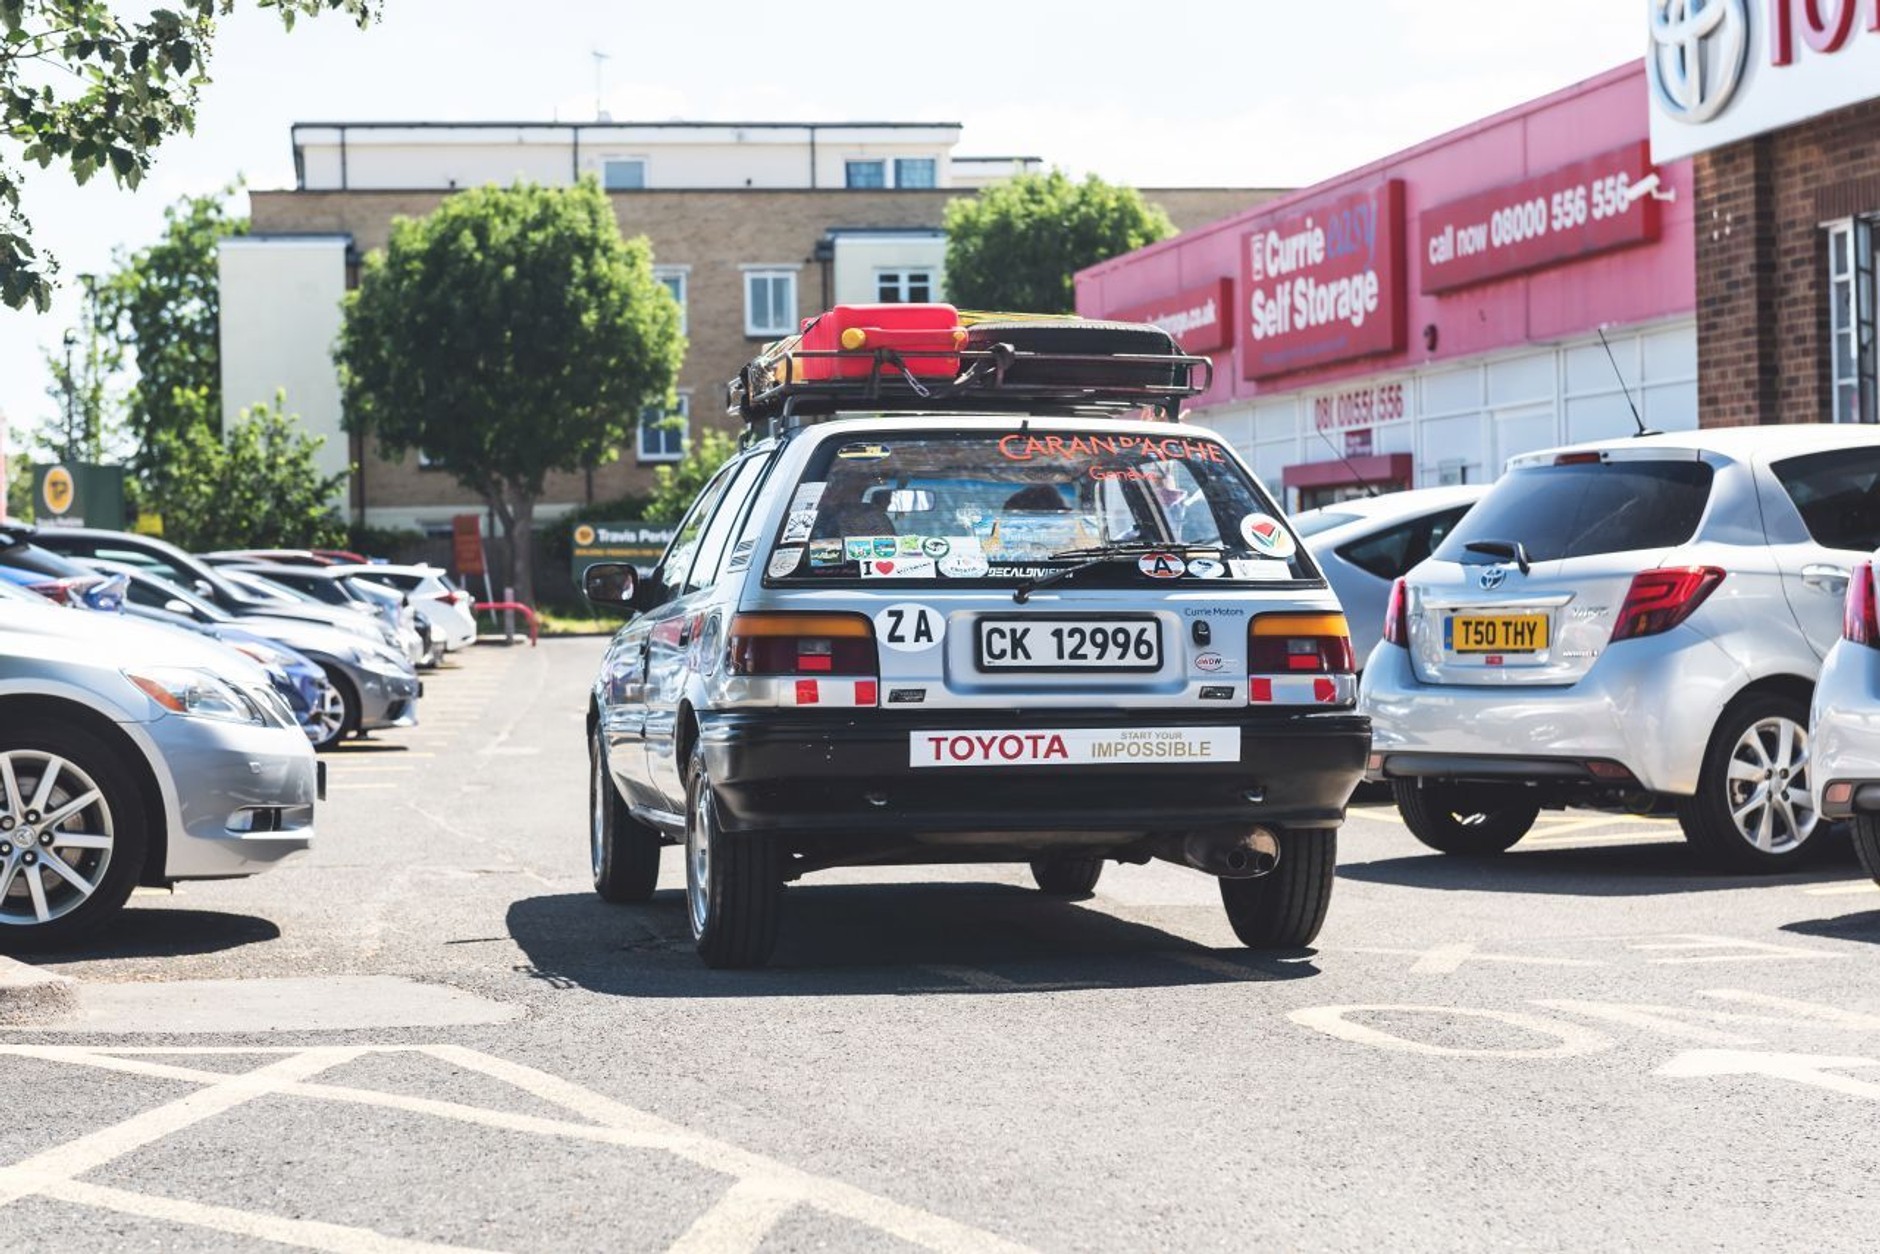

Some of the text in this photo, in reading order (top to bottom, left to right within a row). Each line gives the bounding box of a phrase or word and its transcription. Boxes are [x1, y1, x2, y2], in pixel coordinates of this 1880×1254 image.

[1429, 171, 1631, 265] call now 08000 556 556
[1265, 216, 1326, 278] Currie
[1251, 269, 1379, 341] Self Storage
[597, 528, 637, 543] Travis
[863, 561, 873, 576] I
[1153, 556, 1173, 574] A
[1184, 607, 1244, 616] Currie Motors
[986, 626, 1154, 661] CK 12996
[1461, 620, 1538, 646] T50 THY
[927, 733, 1069, 761] TOYOTA
[1121, 732, 1182, 740] START YOUR
[1090, 741, 1212, 759] IMPOSSIBLE
